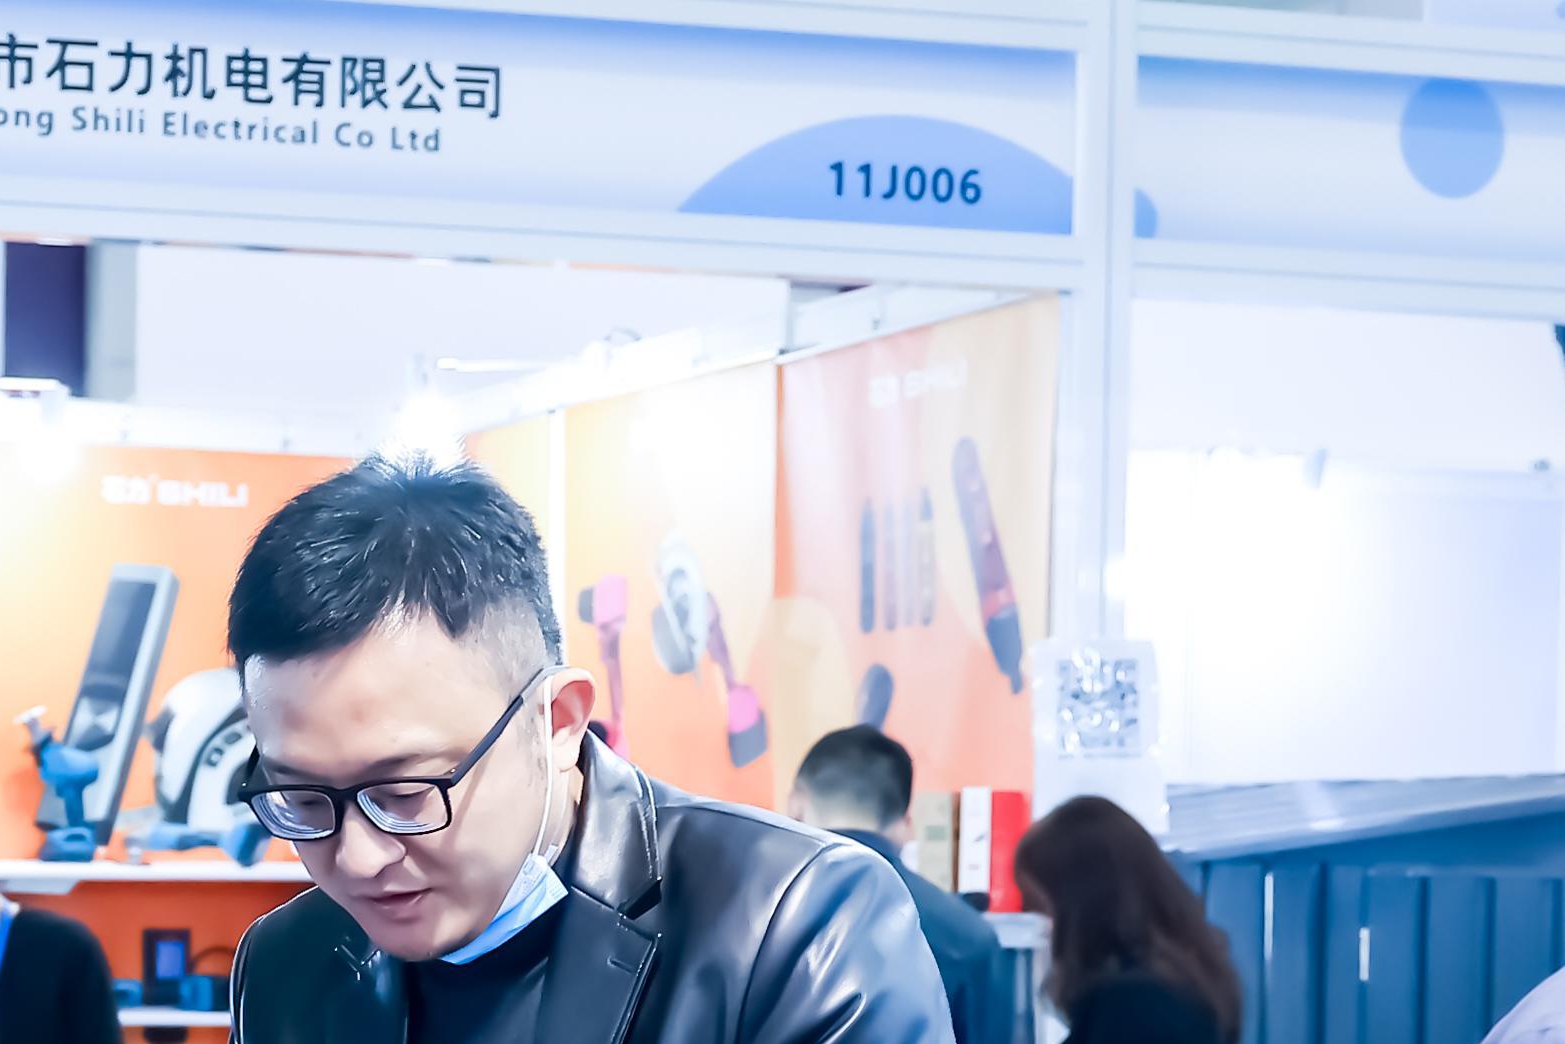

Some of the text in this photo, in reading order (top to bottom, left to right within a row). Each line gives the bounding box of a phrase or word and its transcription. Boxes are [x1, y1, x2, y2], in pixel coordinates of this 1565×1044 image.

[72, 106, 146, 134] Shili
[162, 111, 319, 146] Electrical
[334, 122, 374, 149] Co
[391, 125, 441, 153] Ltd
[829, 161, 982, 205] 11J006
